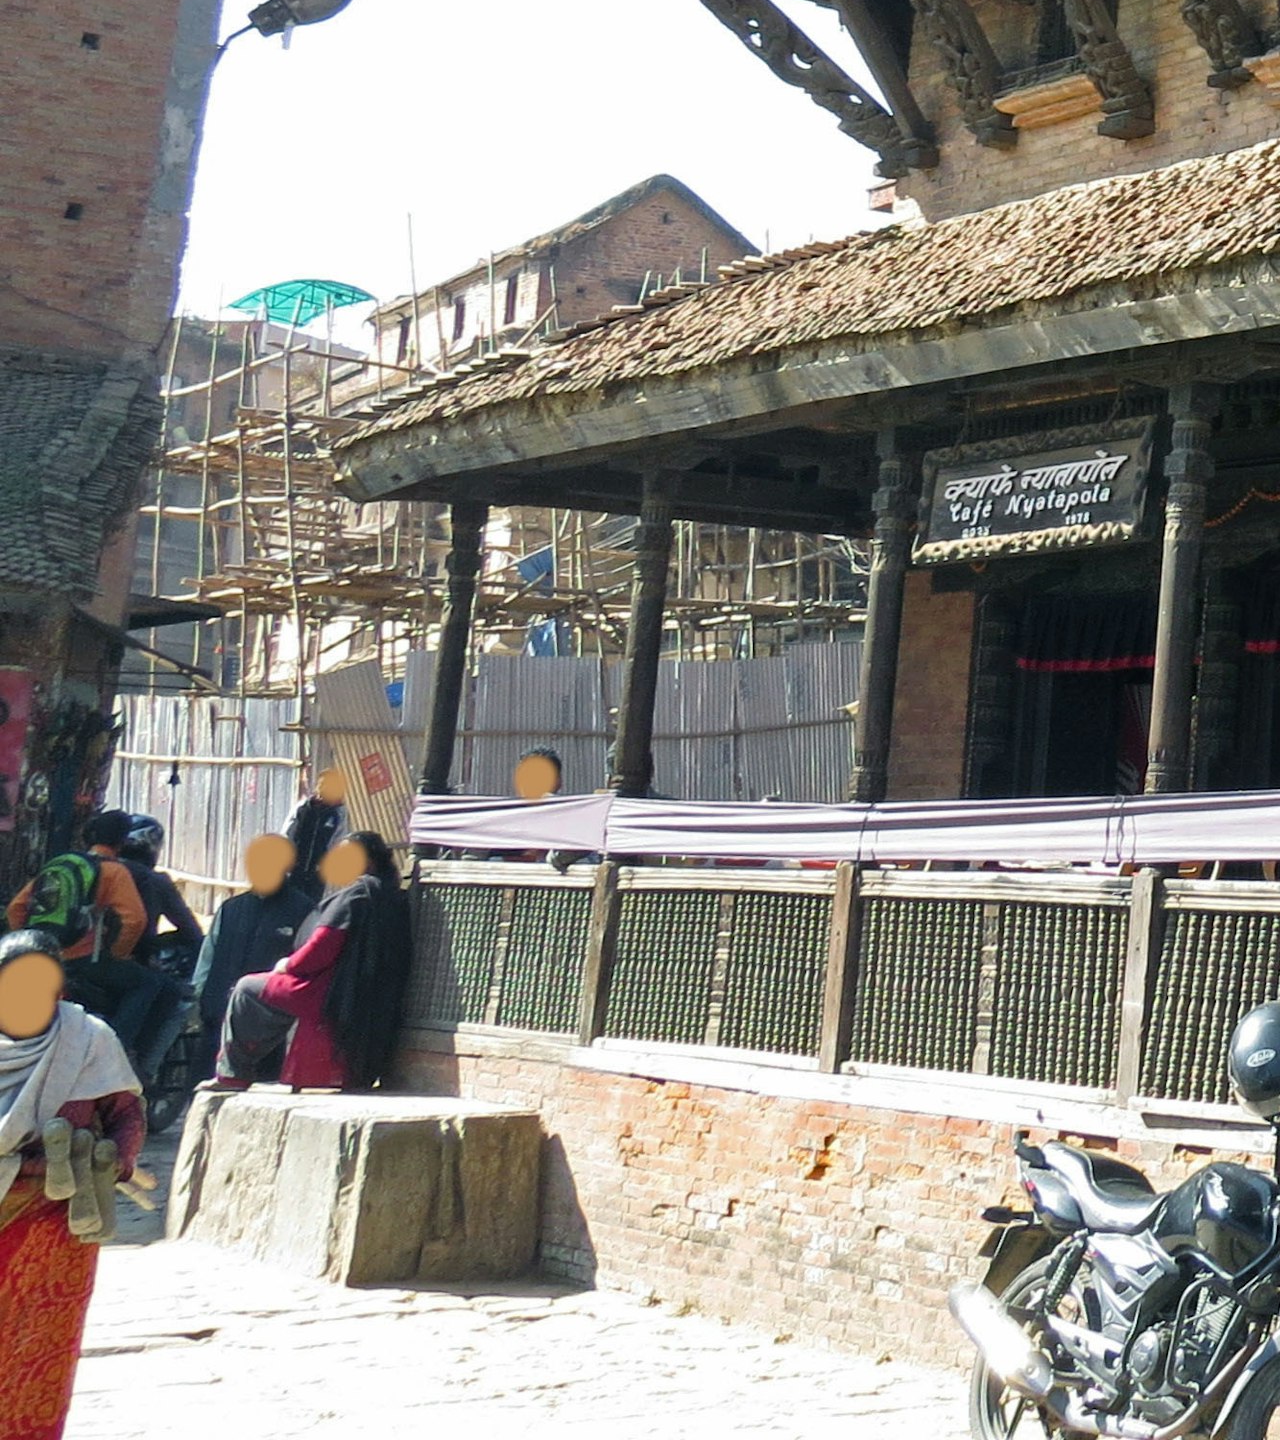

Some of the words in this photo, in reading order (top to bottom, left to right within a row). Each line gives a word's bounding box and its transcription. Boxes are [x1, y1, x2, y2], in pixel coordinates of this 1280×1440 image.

[949, 498, 993, 526] Café
[1004, 483, 1112, 519] Nyatapola
[1065, 512, 1091, 526] 1978
